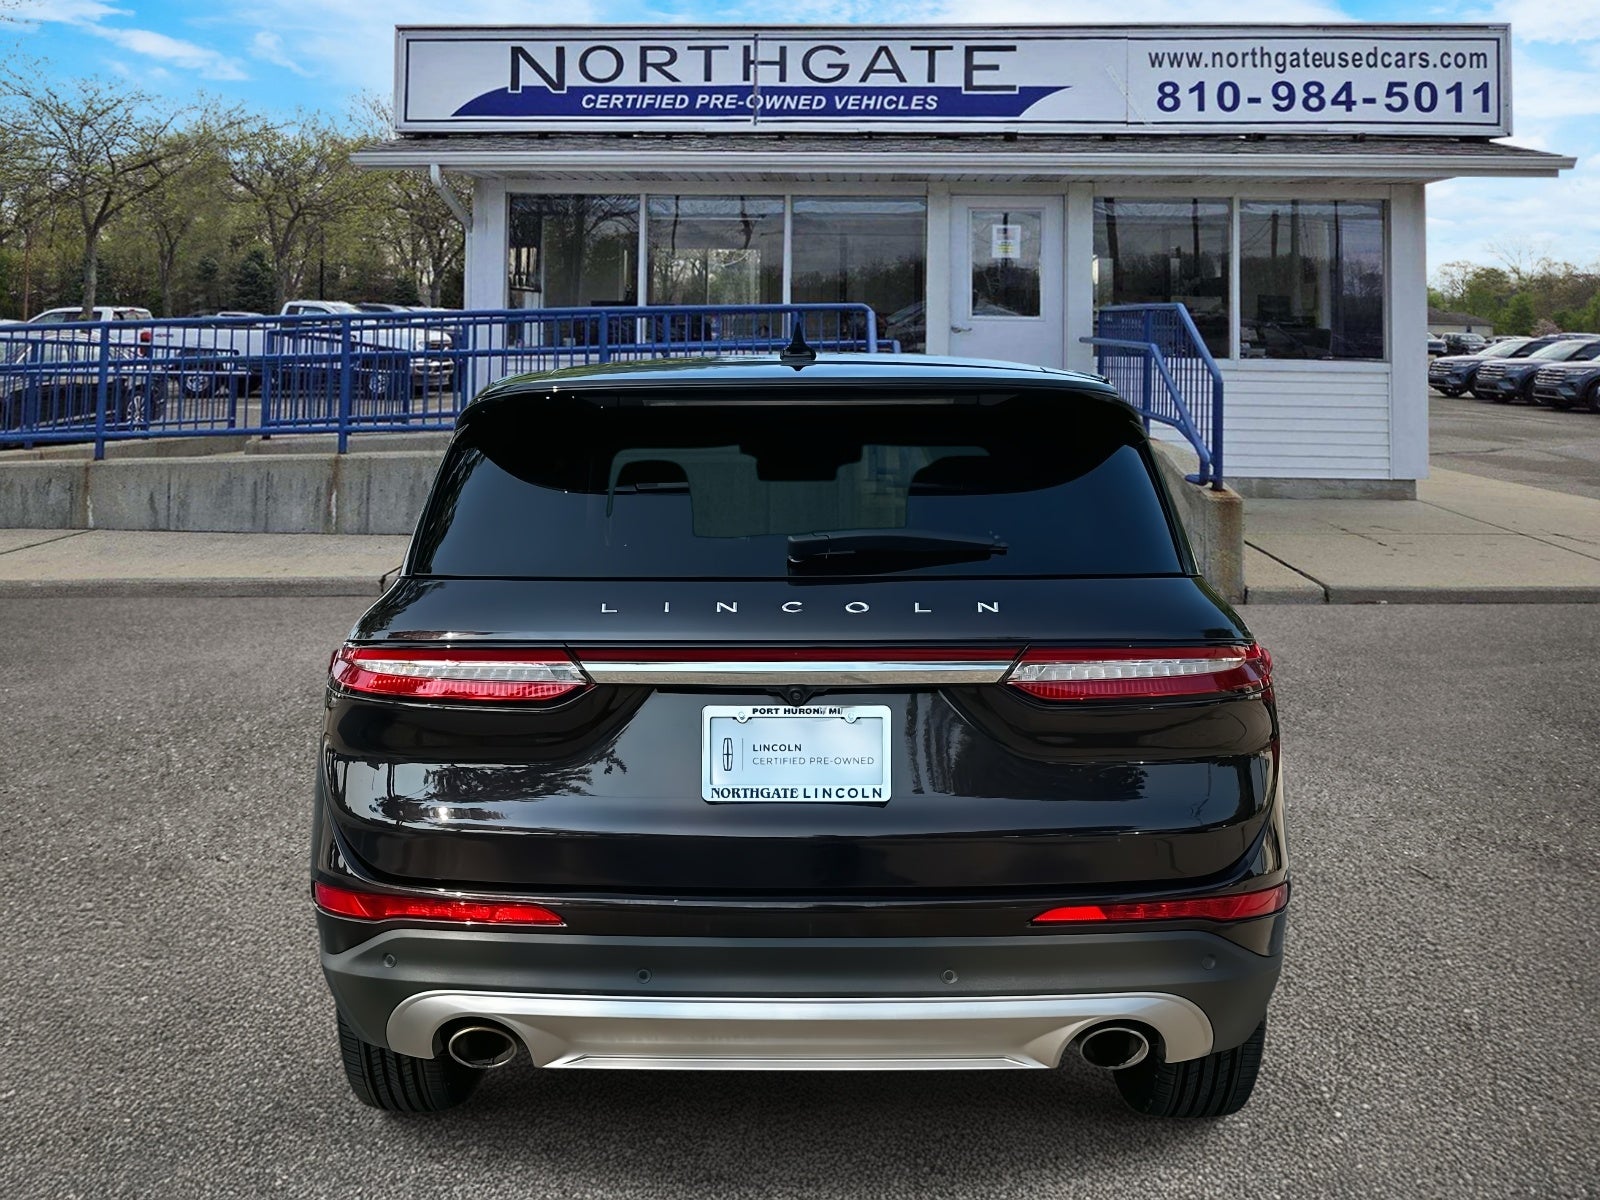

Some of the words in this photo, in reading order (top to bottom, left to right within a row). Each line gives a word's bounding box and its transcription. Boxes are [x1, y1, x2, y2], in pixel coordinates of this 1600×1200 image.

[1148, 46, 1489, 74] www.northgateusedcars.com
[509, 44, 1018, 93] NORTHGATE
[580, 93, 690, 110] CERTIFIED
[695, 93, 826, 111] PRE-OWNED
[834, 95, 939, 112] VEHICLES
[1156, 80, 1492, 114] 810-984-5011
[600, 601, 1001, 614] LINCOLN
[752, 707, 780, 715] PORT
[828, 707, 842, 715] MI
[752, 743, 802, 752] LINCOLN
[752, 757, 806, 765] CERTIFIED
[809, 757, 875, 765] PRE-OWNED
[711, 787, 799, 799] NORTHGATE
[803, 787, 882, 799] LINCOLN
